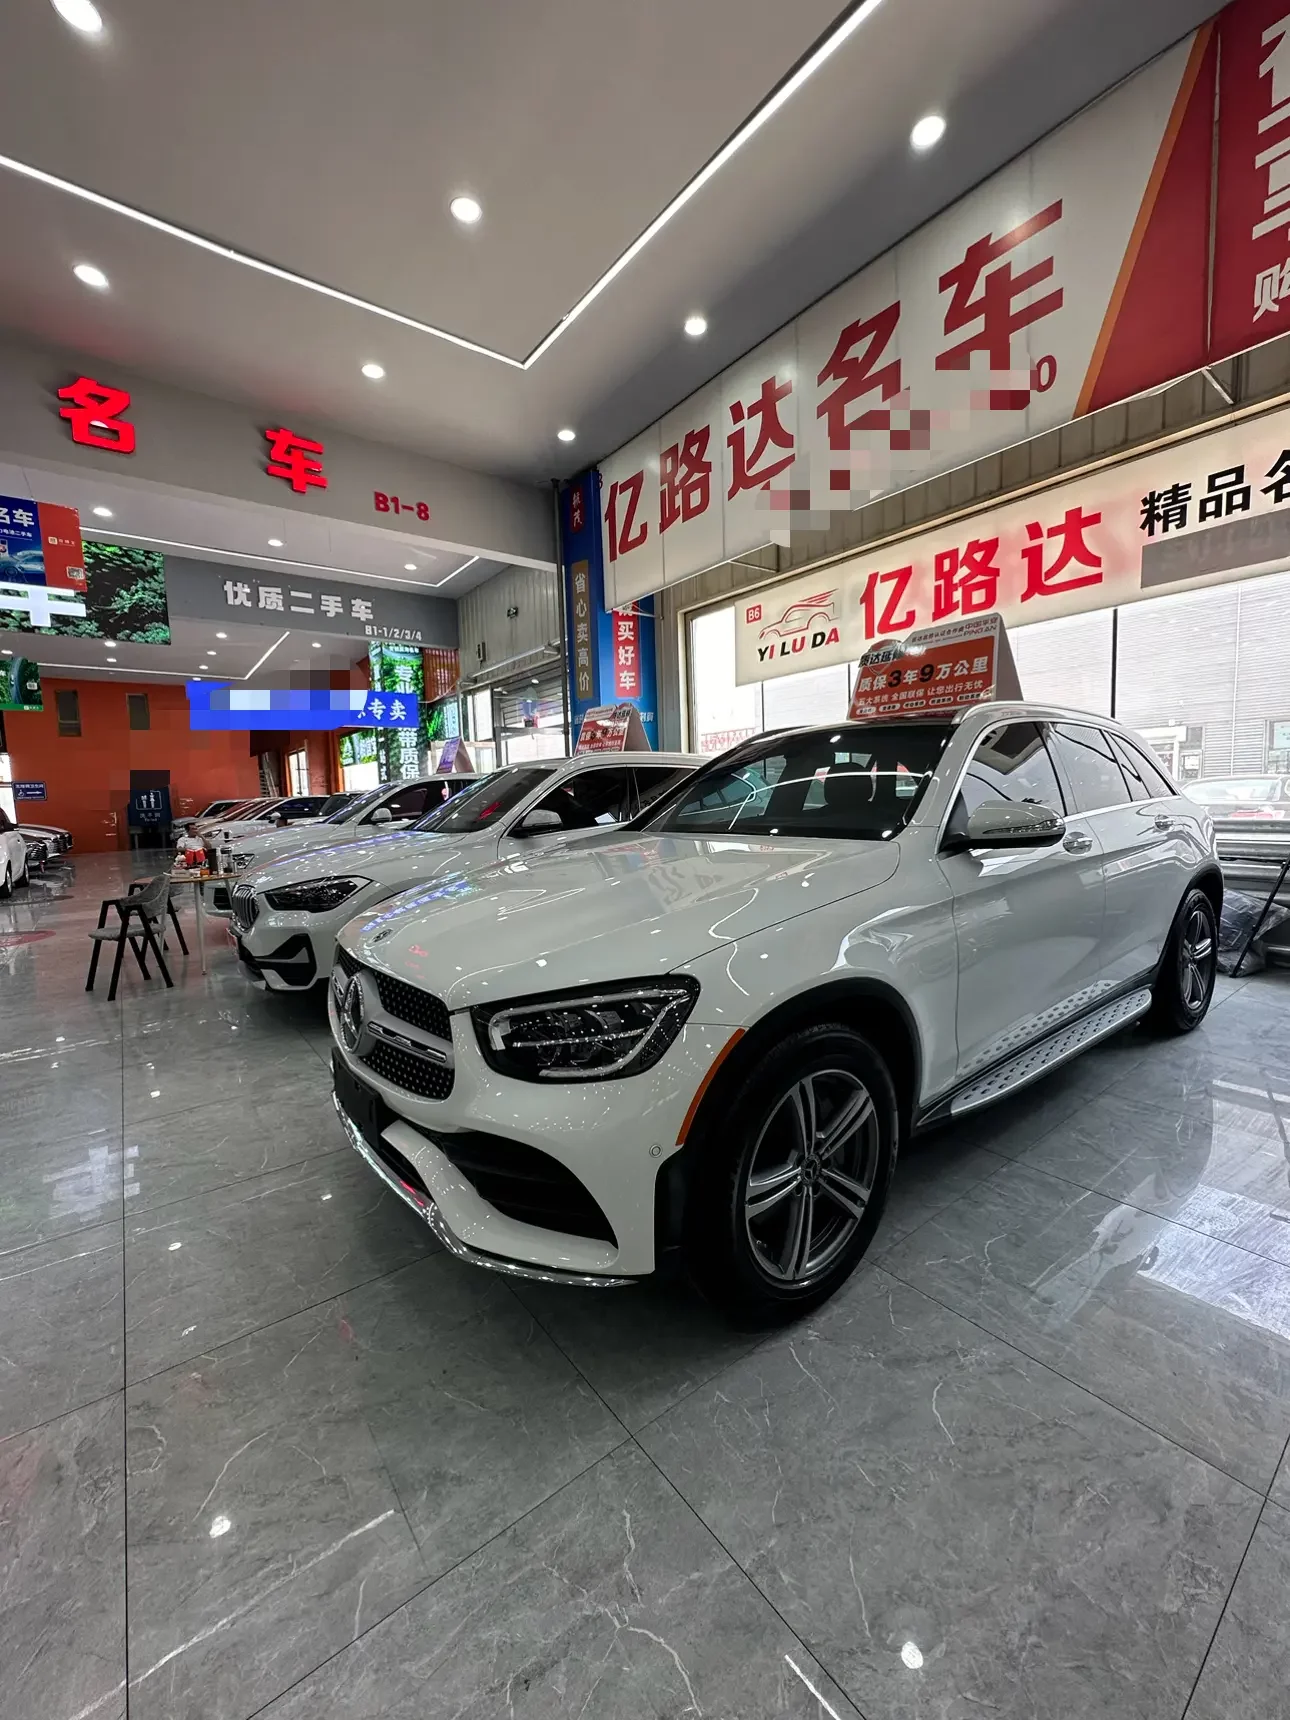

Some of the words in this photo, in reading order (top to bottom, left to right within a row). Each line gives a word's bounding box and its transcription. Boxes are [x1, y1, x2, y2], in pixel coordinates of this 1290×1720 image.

[604, 199, 1063, 563] 亿路达名车
[373, 490, 430, 522] B1-8
[859, 506, 1104, 641] 亿路达
[223, 580, 374, 622] 优质二手车
[748, 607, 760, 621] B6
[364, 624, 423, 642] B1-1/2/3/4
[575, 572, 590, 692] 省心卖高价
[757, 644, 776, 662] YI
[780, 635, 806, 657] LU
[812, 627, 841, 649] DA
[857, 655, 989, 693] 质保3年9万公里
